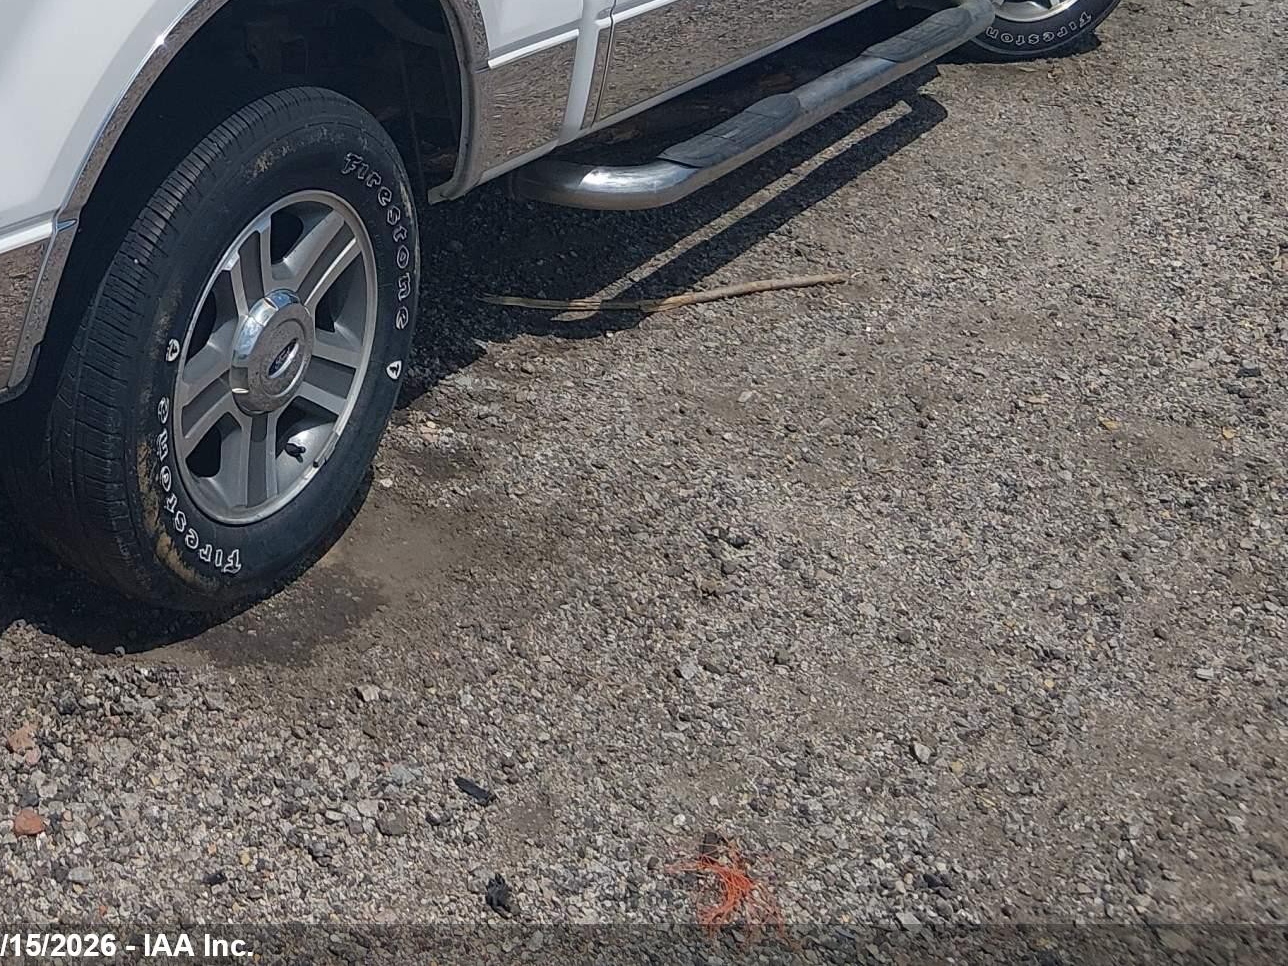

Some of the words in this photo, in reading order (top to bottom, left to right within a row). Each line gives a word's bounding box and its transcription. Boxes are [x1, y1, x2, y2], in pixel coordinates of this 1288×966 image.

[985, 11, 1092, 46] Fireston
[341, 151, 411, 330] Firestone
[157, 397, 242, 574] Firestone
